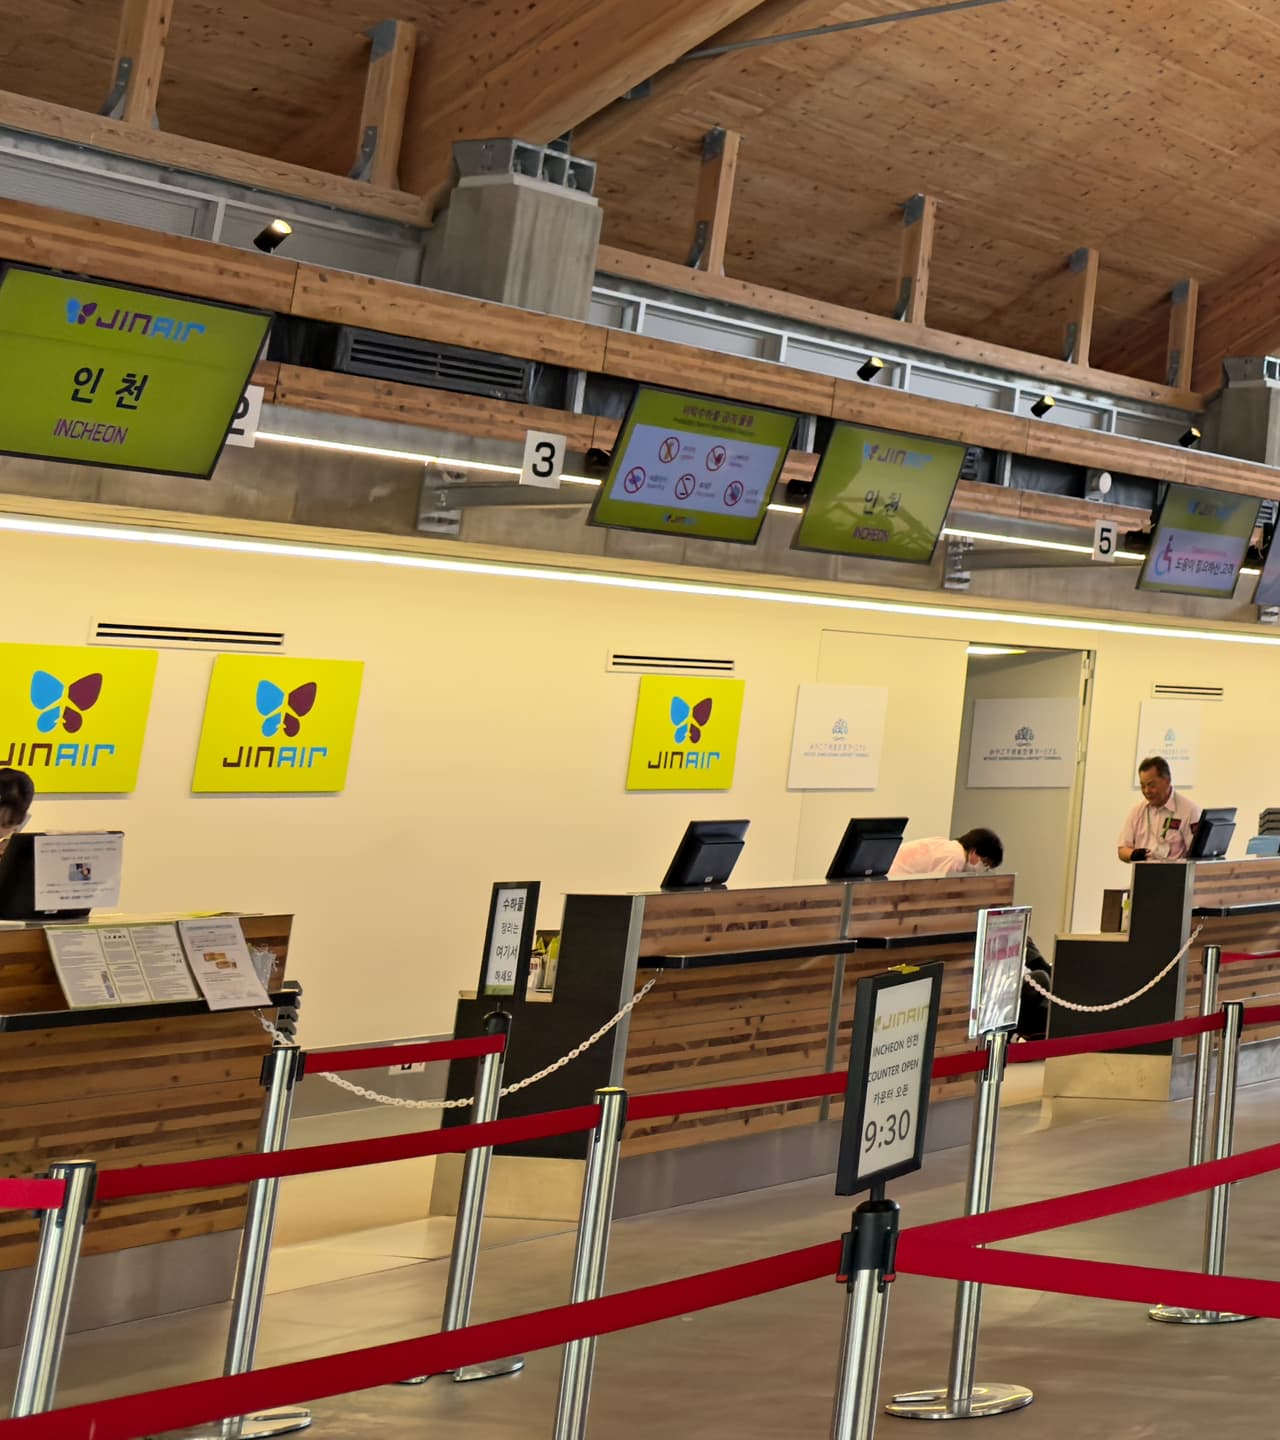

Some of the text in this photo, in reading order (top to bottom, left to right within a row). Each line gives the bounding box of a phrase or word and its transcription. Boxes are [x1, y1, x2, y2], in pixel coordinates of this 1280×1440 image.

[53, 418, 128, 445] INCHEON
[532, 441, 555, 477] 3
[1099, 527, 1112, 554] 5
[503, 897, 524, 912] 수하물
[496, 944, 518, 960] 여기서
[872, 1039, 904, 1057] INCHEON
[901, 1058, 919, 1073] OPEN
[865, 1109, 911, 1153] 9:30
